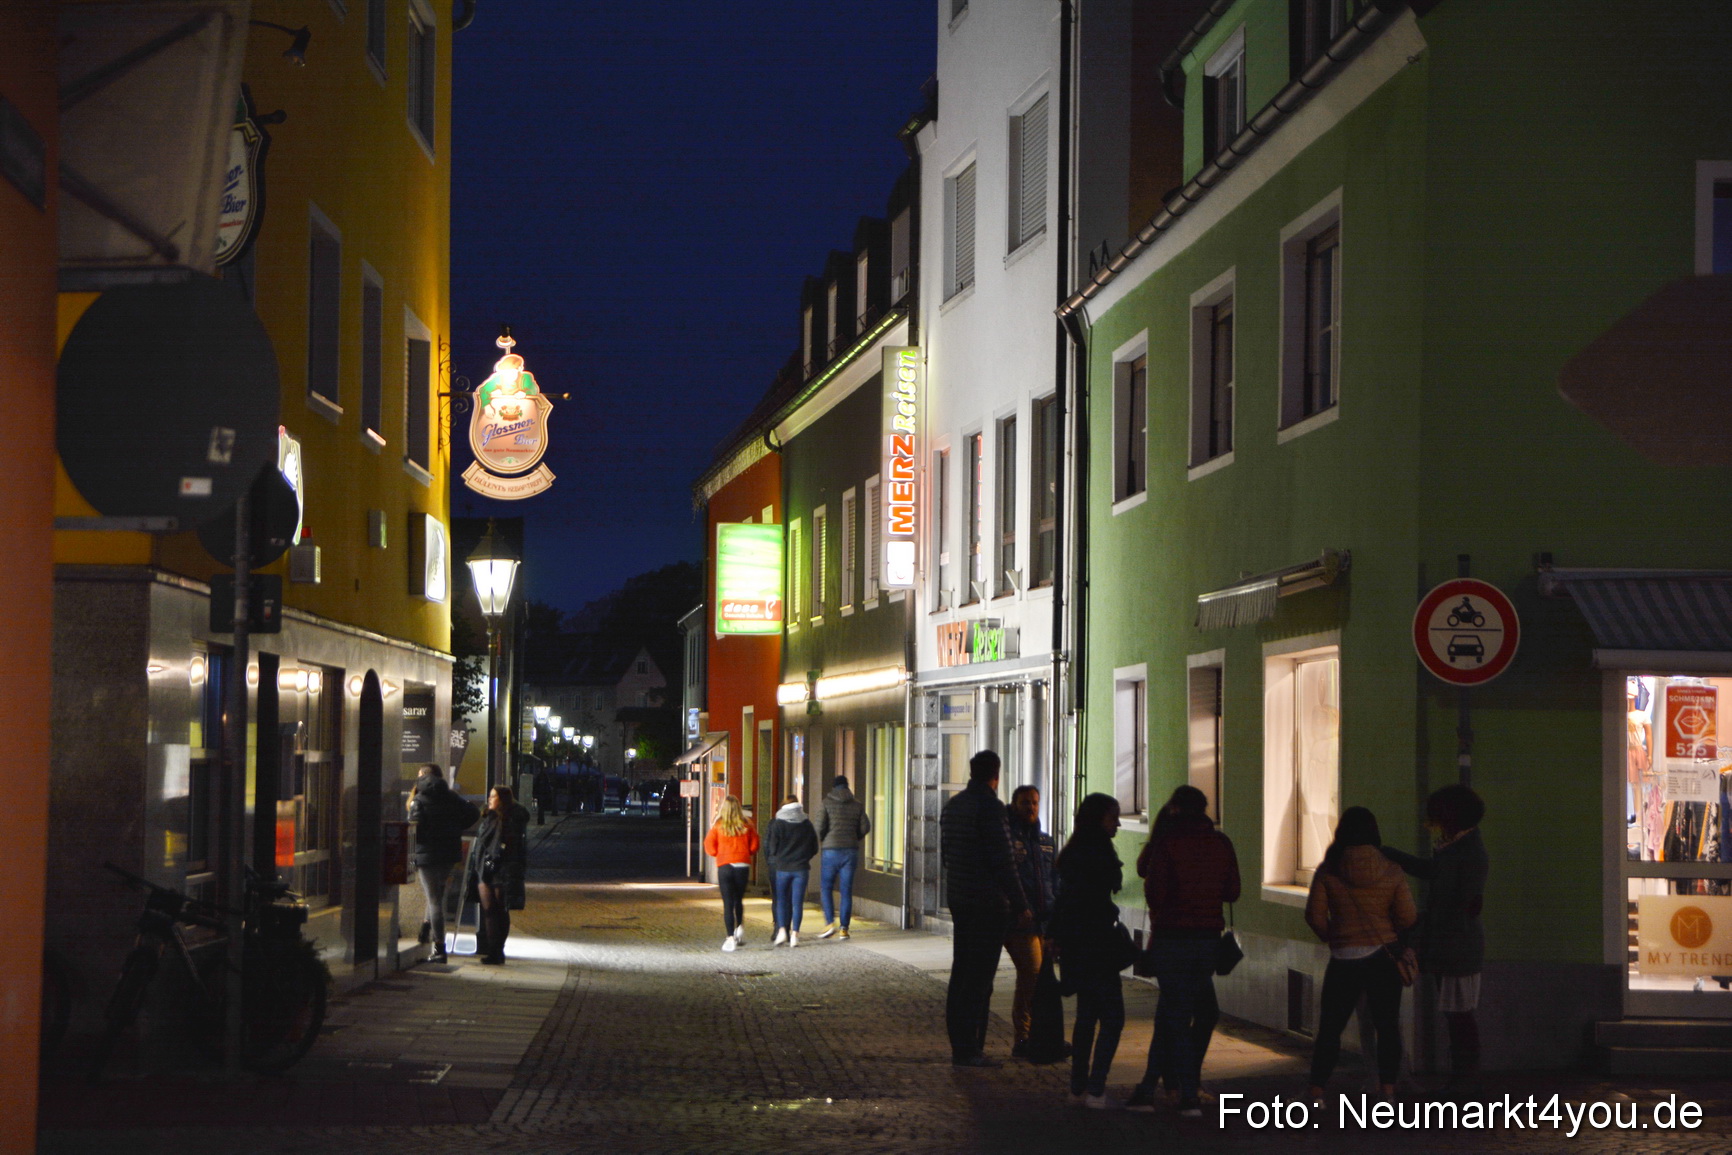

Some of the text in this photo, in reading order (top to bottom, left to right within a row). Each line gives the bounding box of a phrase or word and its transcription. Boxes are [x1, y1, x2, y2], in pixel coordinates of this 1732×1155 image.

[481, 419, 536, 446] Glossner
[514, 434, 537, 445] Bier
[889, 350, 916, 535] MERZ Reisen
[937, 618, 1005, 667] MERZ Reisen
[1647, 951, 1732, 966] MY TREND
